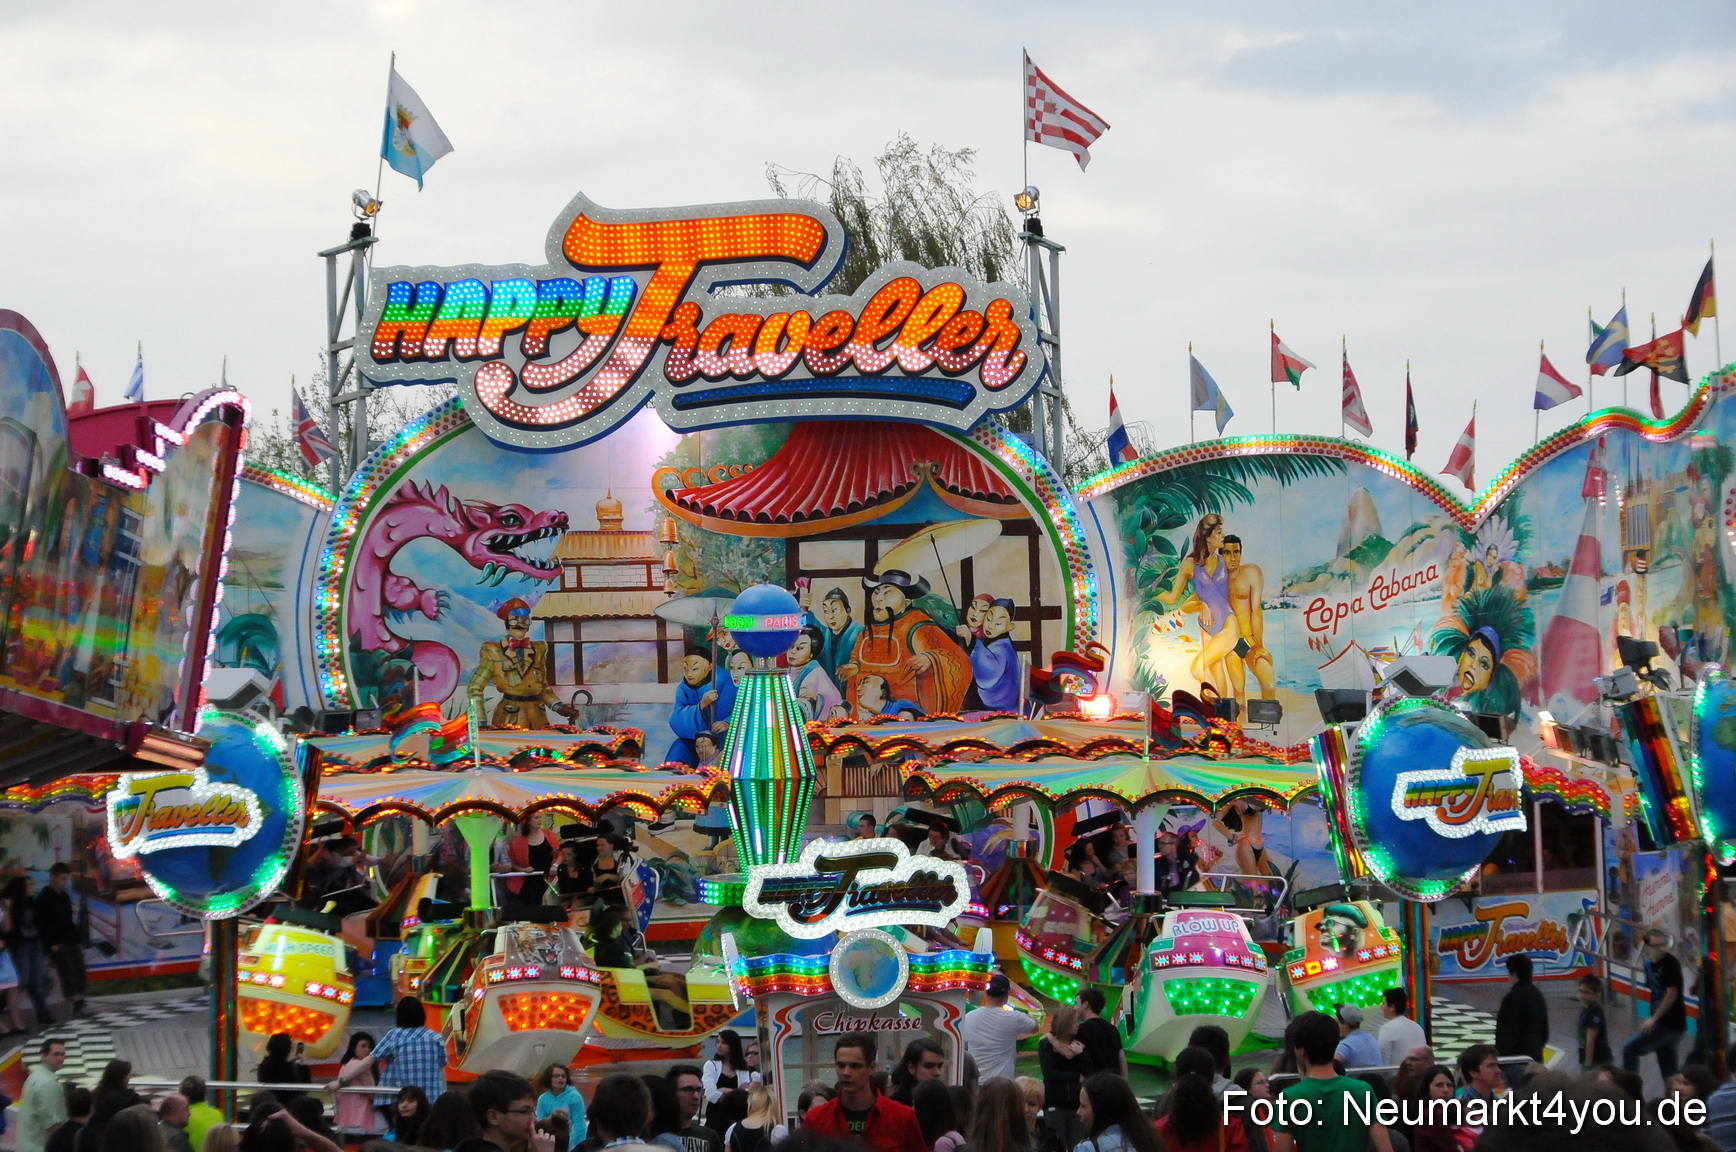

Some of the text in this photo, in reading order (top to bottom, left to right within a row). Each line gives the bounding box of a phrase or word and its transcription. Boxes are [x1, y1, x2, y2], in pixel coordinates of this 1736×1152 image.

[474, 212, 1026, 425] Traveller
[764, 615, 799, 629] PARIS
[1303, 563, 1440, 636] Copa Cabana
[119, 773, 251, 846] Traveller
[786, 851, 959, 925] Traveller
[299, 943, 336, 957] SPEED
[1172, 918, 1239, 936] BLOW UP
[1456, 901, 1570, 969] Traveller
